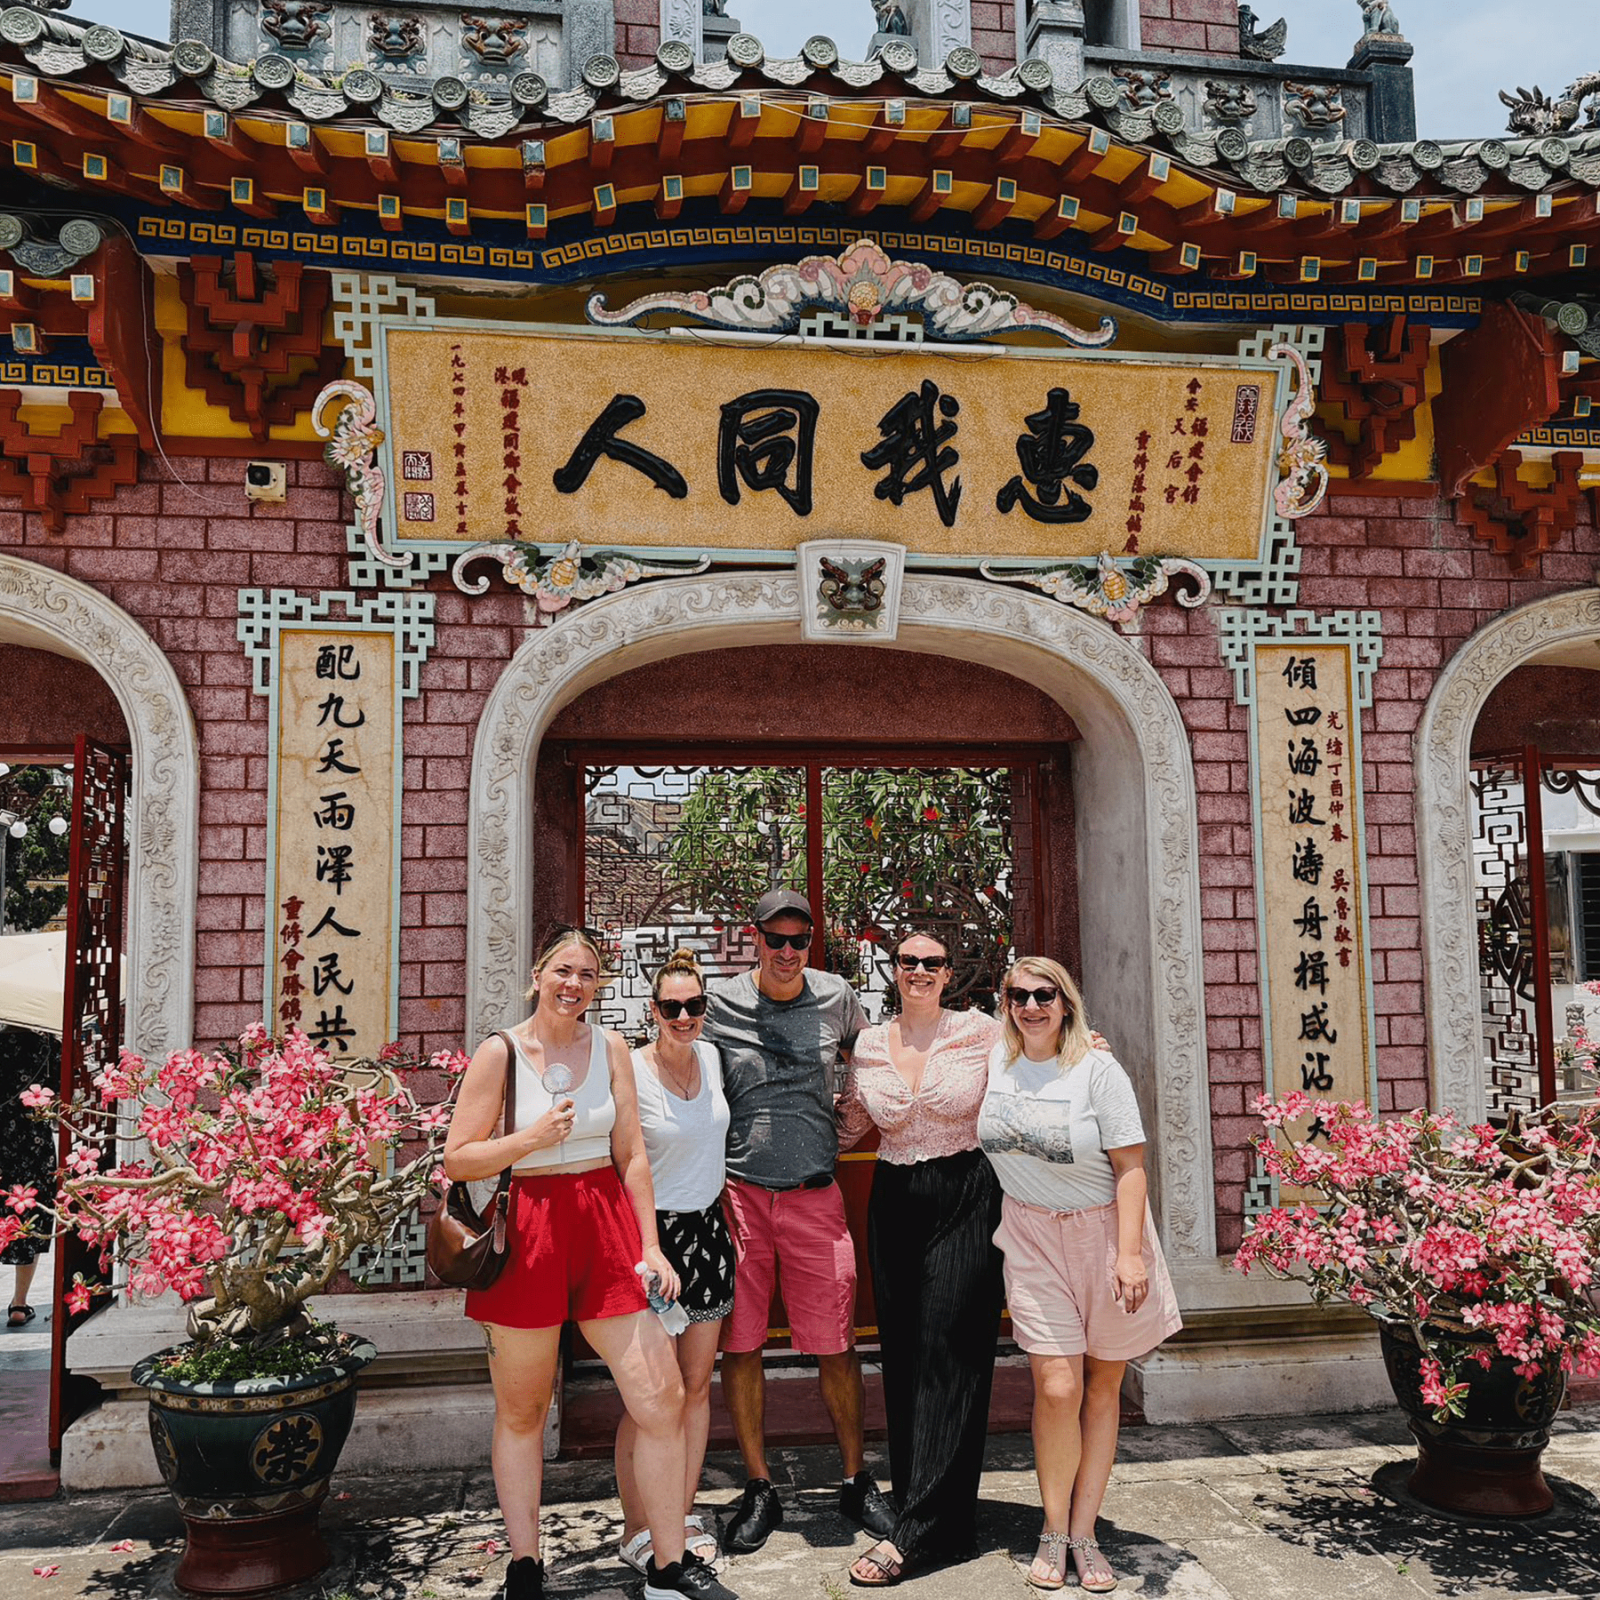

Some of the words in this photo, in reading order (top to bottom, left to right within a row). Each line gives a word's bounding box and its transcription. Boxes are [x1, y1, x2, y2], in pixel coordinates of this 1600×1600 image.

[1163, 416, 1188, 505] 天后宮
[306, 644, 365, 1052] 配九天雨澤人民共
